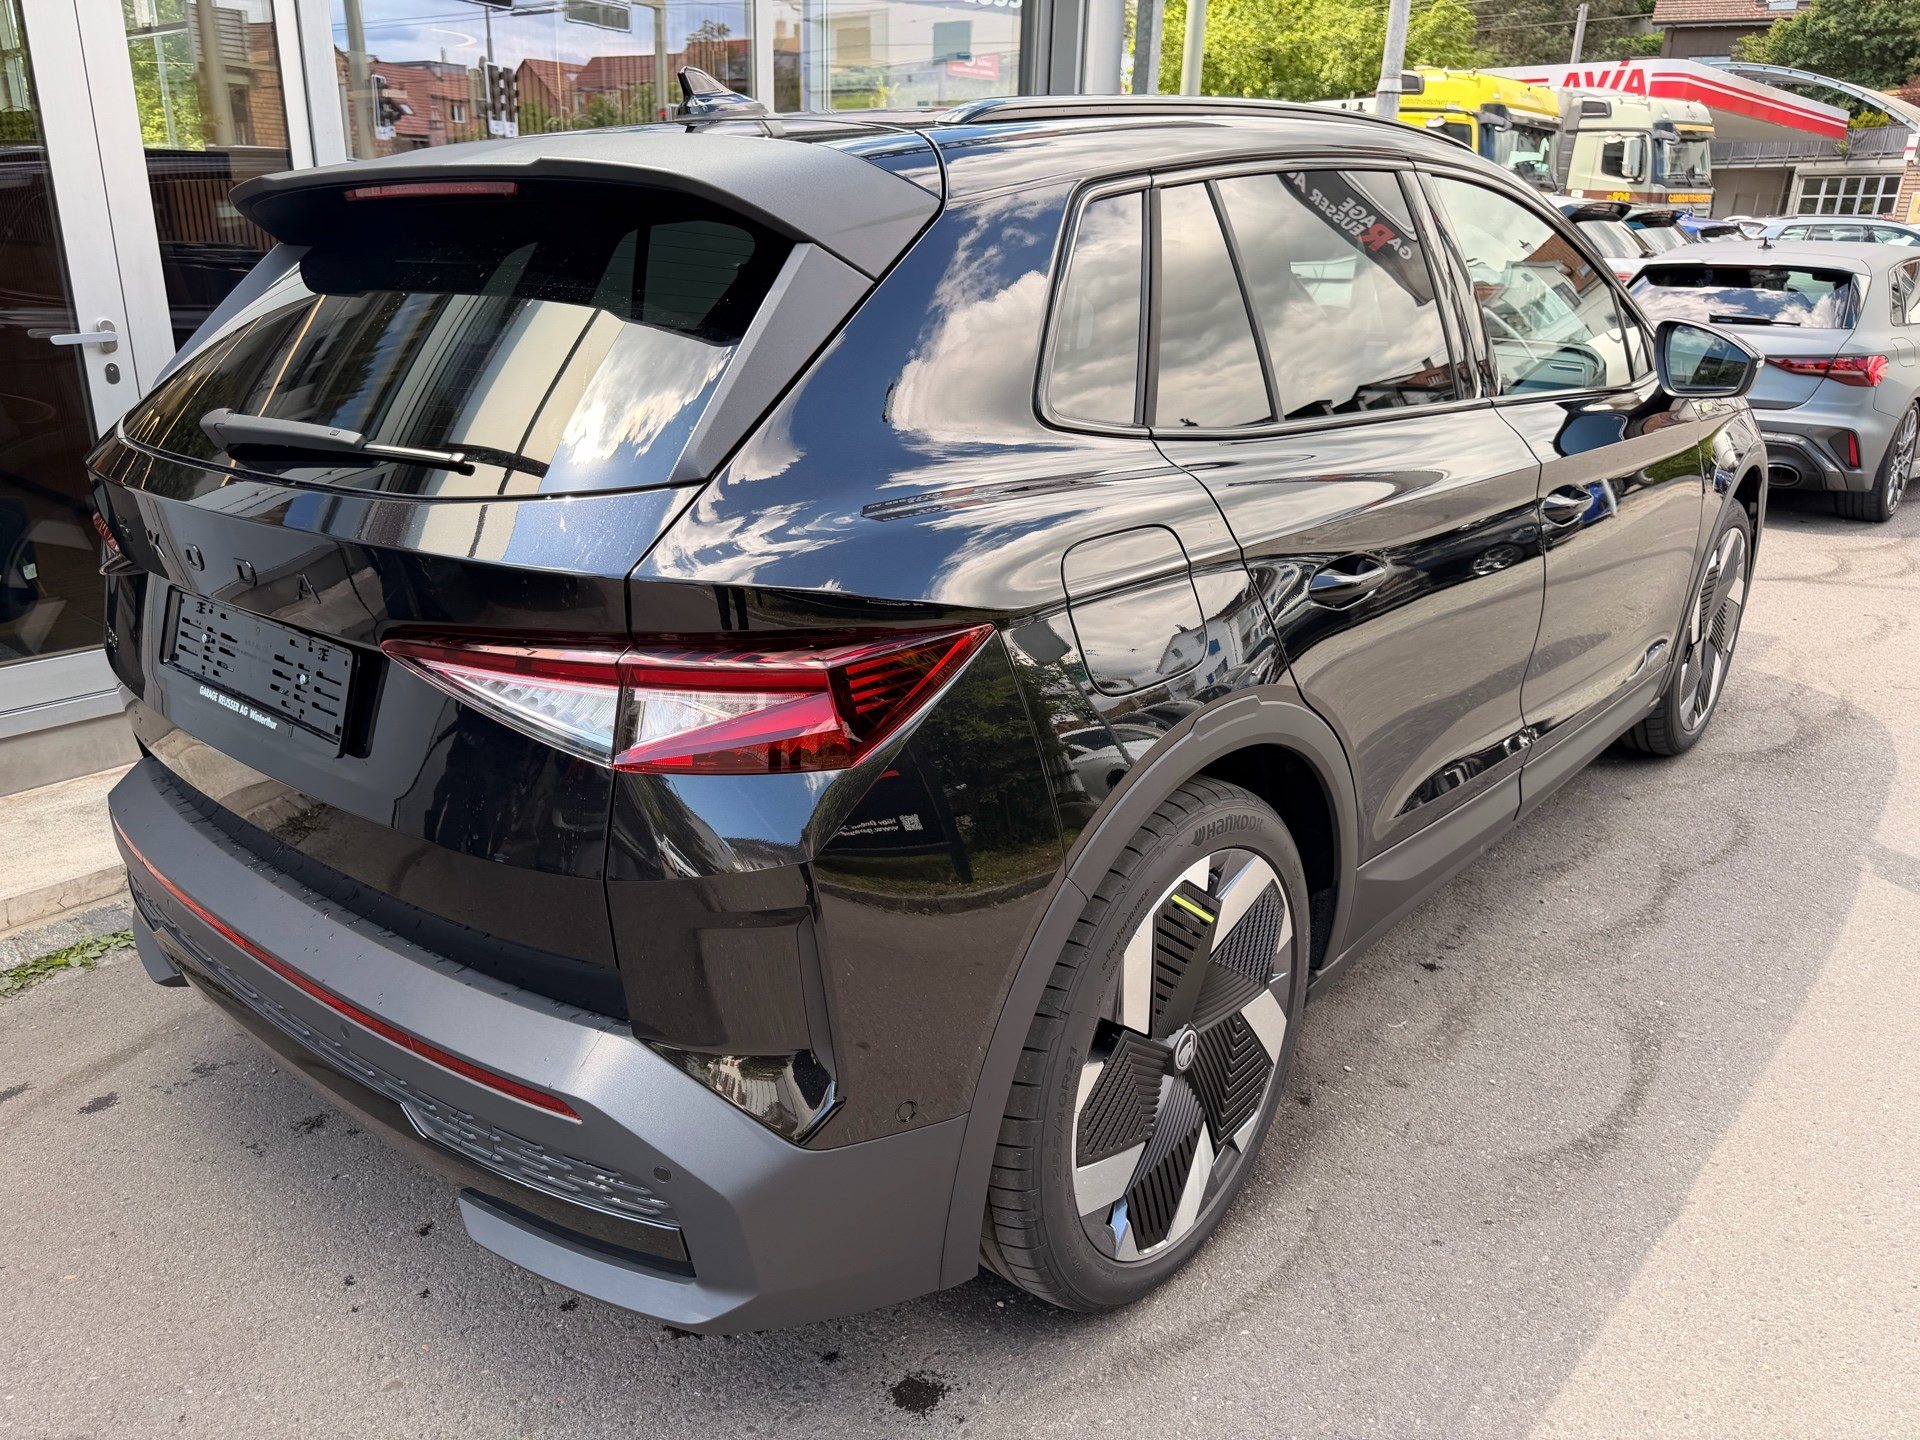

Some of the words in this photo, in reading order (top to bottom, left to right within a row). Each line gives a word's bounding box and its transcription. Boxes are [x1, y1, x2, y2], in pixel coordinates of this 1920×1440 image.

[199, 685, 218, 702] GARAGE
[218, 694, 240, 712] REUSSER
[239, 705, 249, 716] AG
[249, 709, 278, 730] Winterthur
